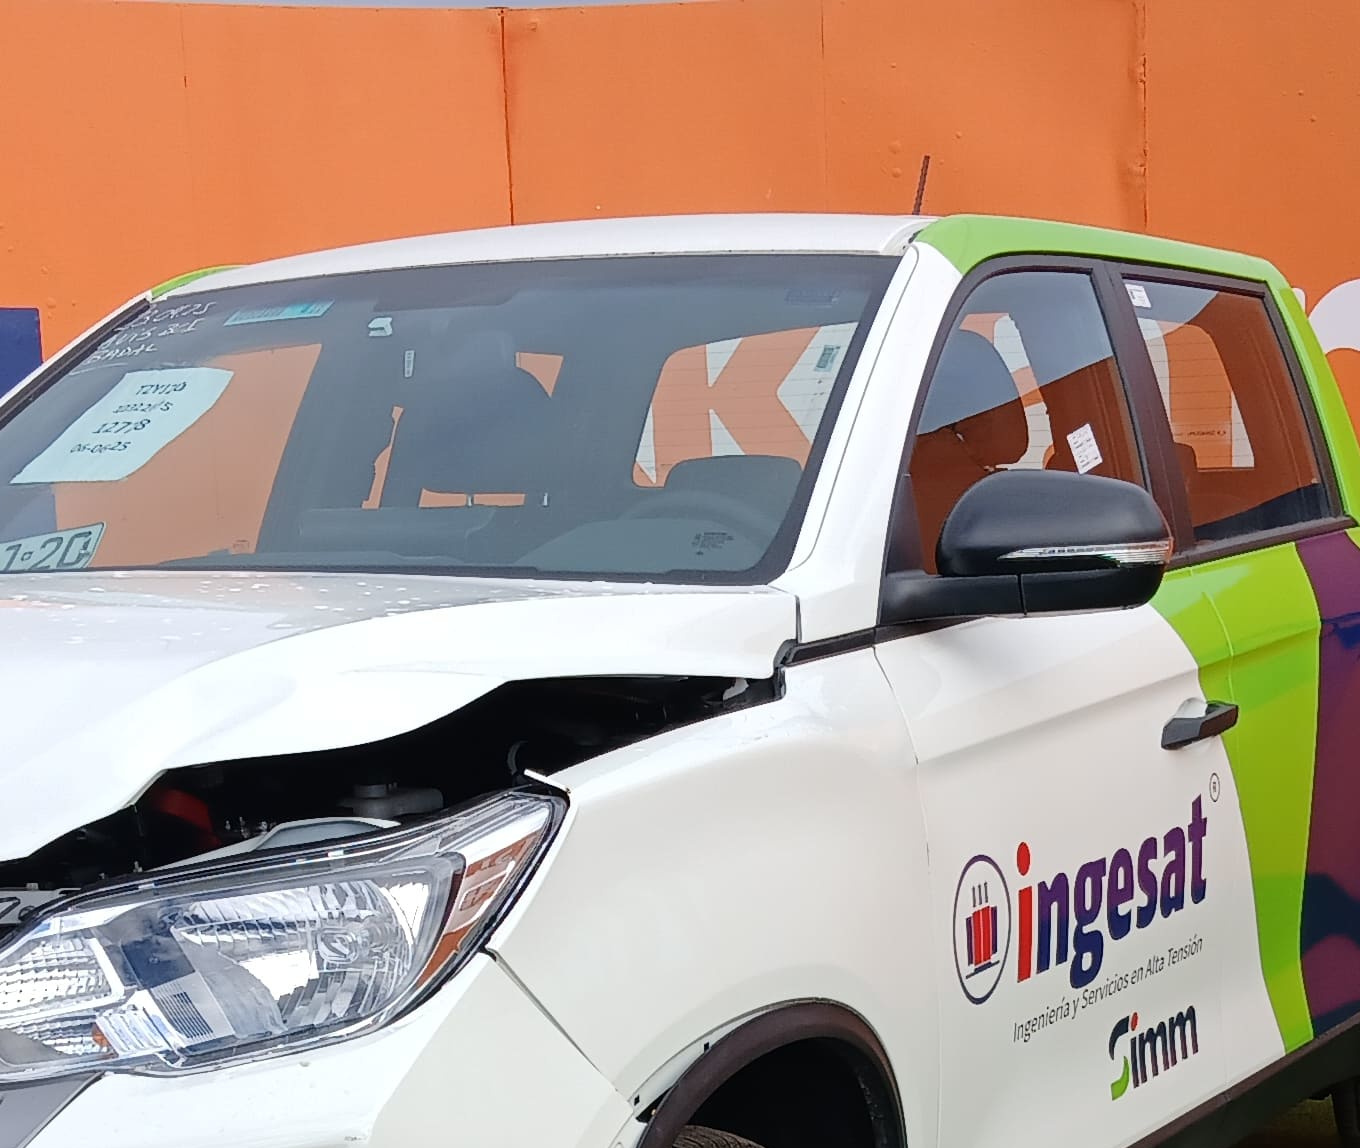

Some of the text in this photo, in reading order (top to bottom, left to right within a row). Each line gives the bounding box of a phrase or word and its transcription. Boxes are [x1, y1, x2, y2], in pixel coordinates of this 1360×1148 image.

[1016, 793, 1208, 990] ingesat
[1013, 933, 1203, 1043] Ingeniería y Servicios en Alta Tensión
